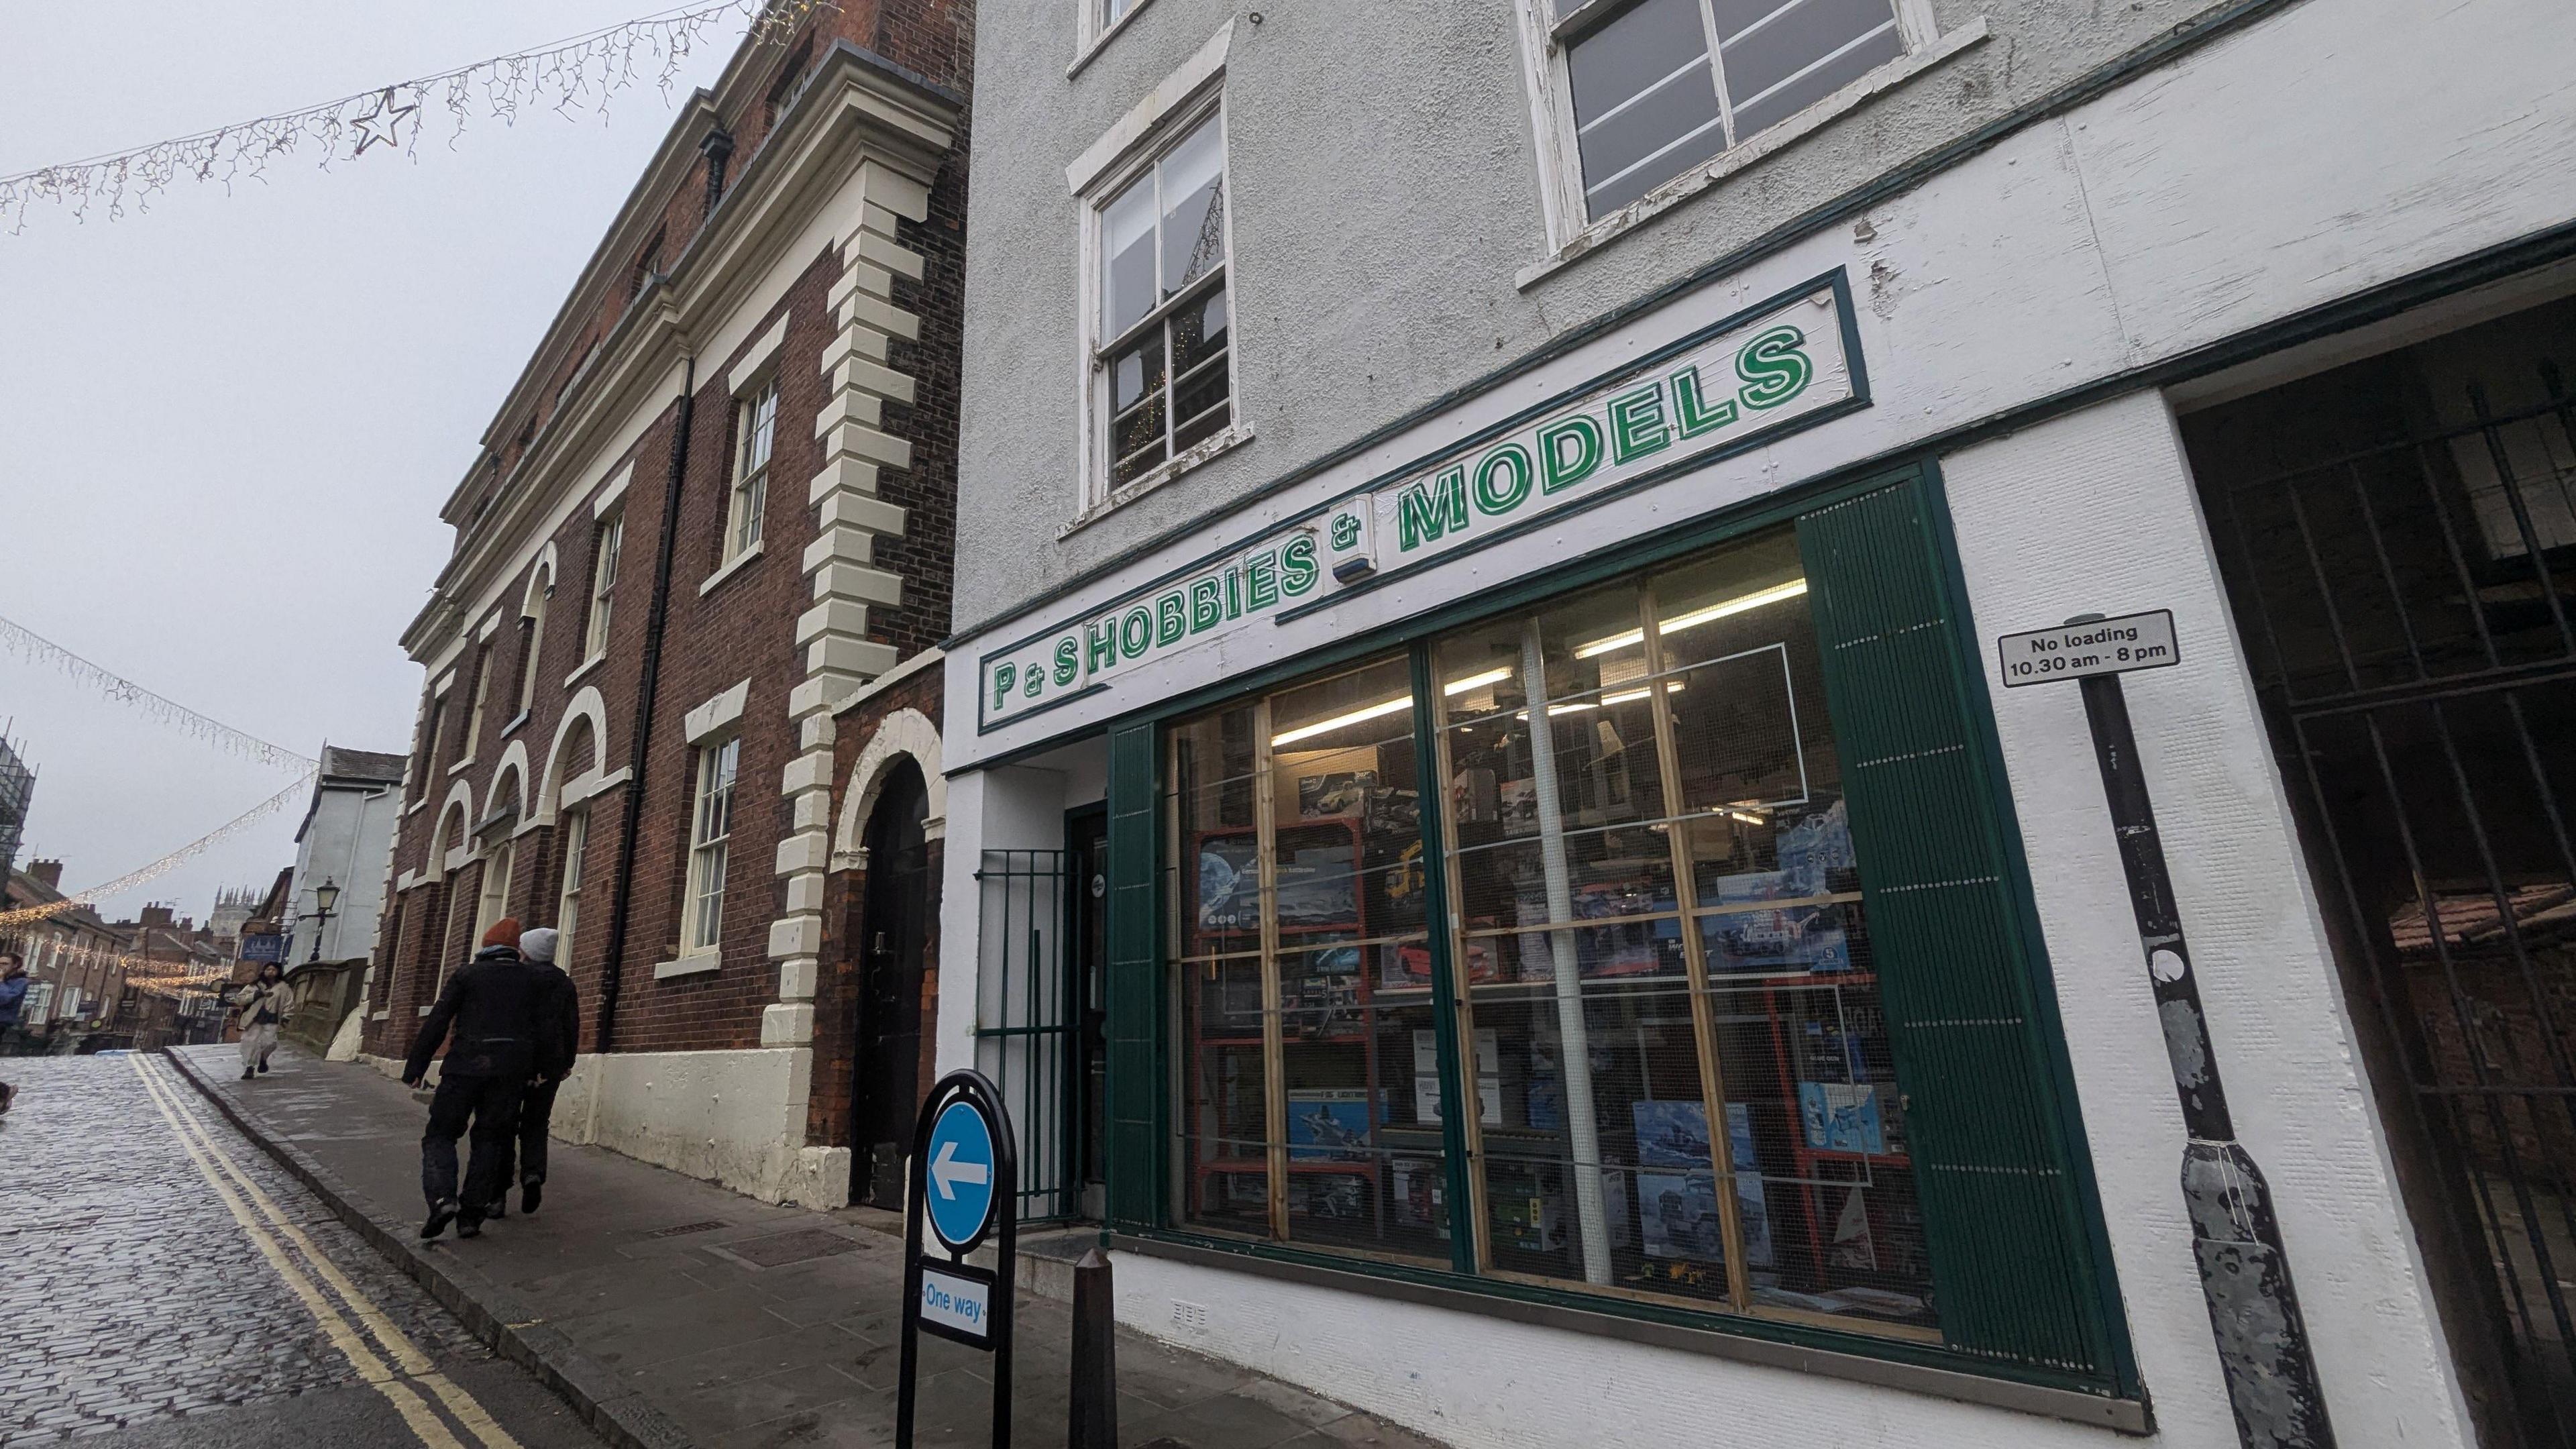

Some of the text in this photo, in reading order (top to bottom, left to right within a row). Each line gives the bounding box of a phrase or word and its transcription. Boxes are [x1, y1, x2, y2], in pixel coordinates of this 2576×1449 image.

[994, 661, 1016, 710] P
[1024, 663, 1044, 697] &
[1331, 513, 1361, 551] &
[1398, 325, 1813, 552] MODELS
[2031, 627, 2138, 653] No loading
[2010, 657, 2066, 676] 10.30
[2072, 654, 2100, 667] am
[2117, 647, 2130, 662] 8
[2136, 645, 2166, 662] pm
[927, 1283, 981, 1324] One way
